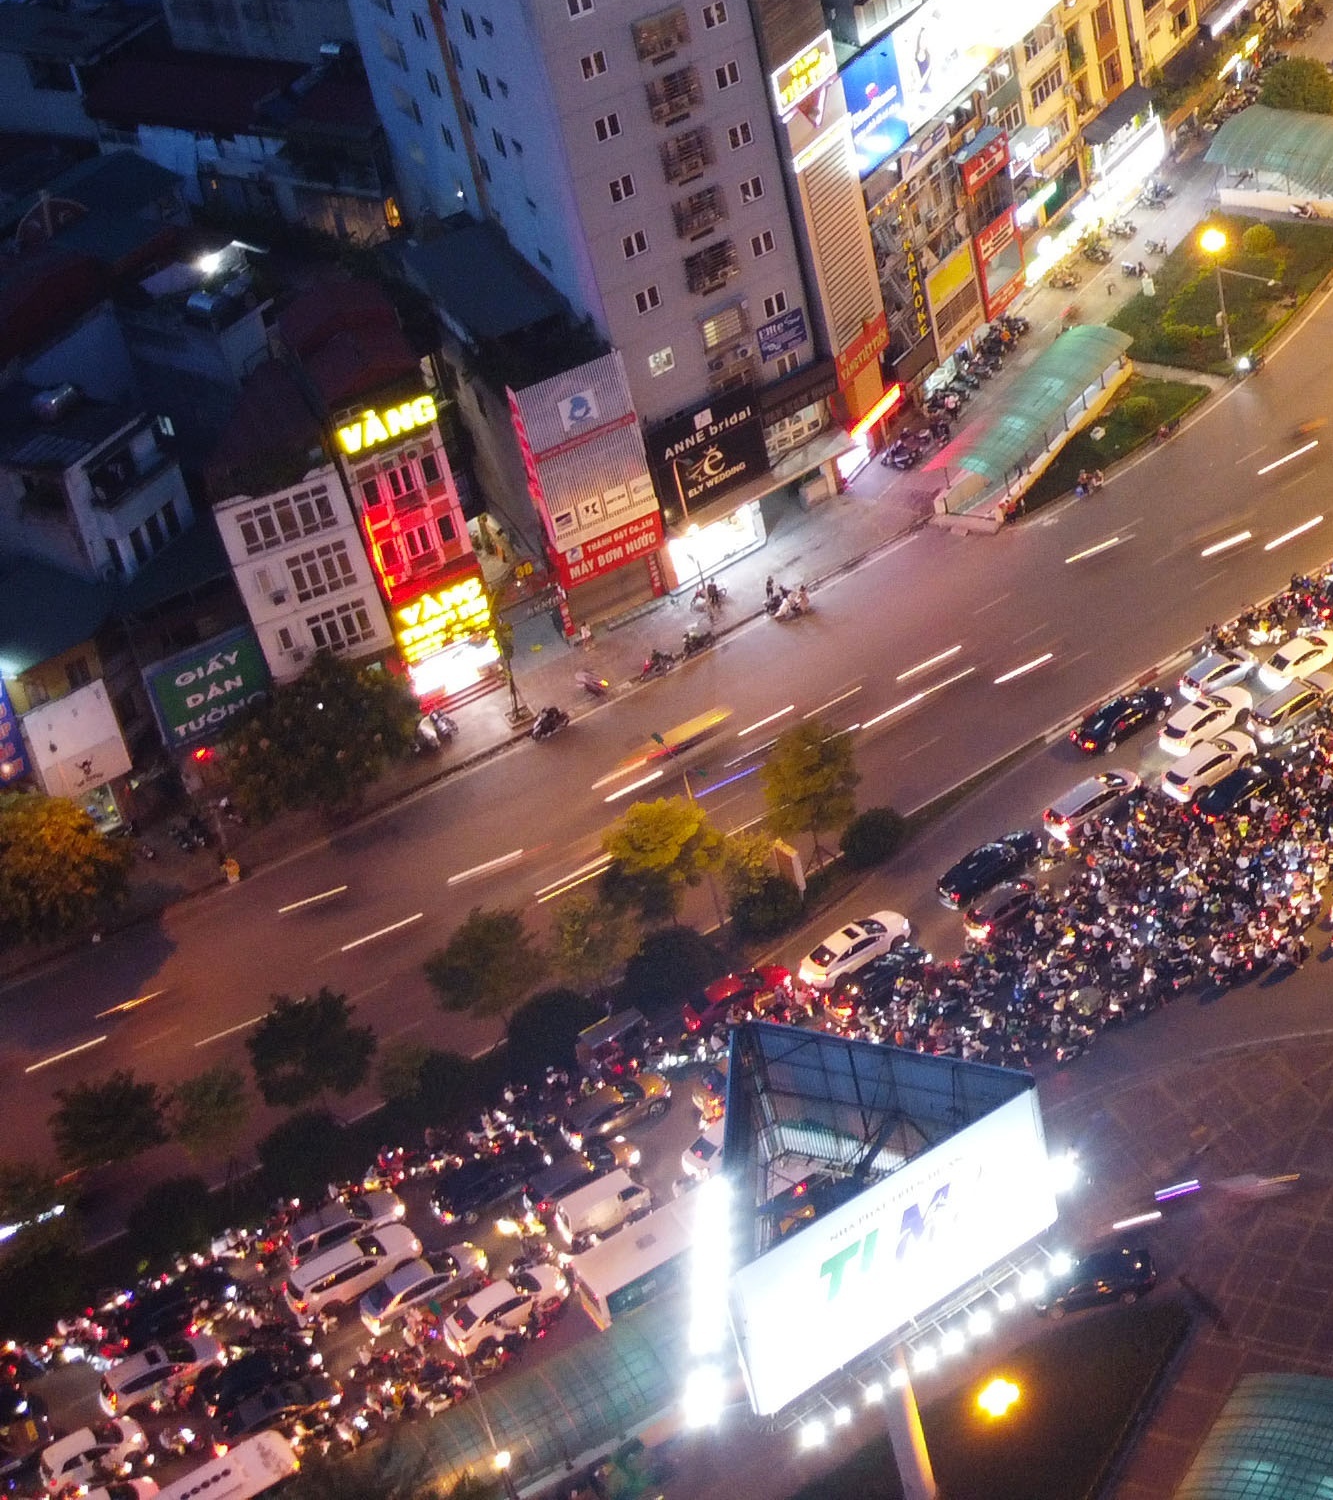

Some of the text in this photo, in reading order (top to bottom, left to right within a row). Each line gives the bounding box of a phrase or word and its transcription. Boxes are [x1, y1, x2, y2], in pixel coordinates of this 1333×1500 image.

[902, 238, 929, 337] KARAOKE
[336, 395, 438, 455] VÀNG
[664, 406, 752, 461] ANNE bridal
[688, 461, 747, 499] ELY WEDDING
[568, 530, 657, 580] MÁY BƠM NƯỚC
[174, 649, 239, 688] GIẤY
[184, 674, 244, 710] DÁN
